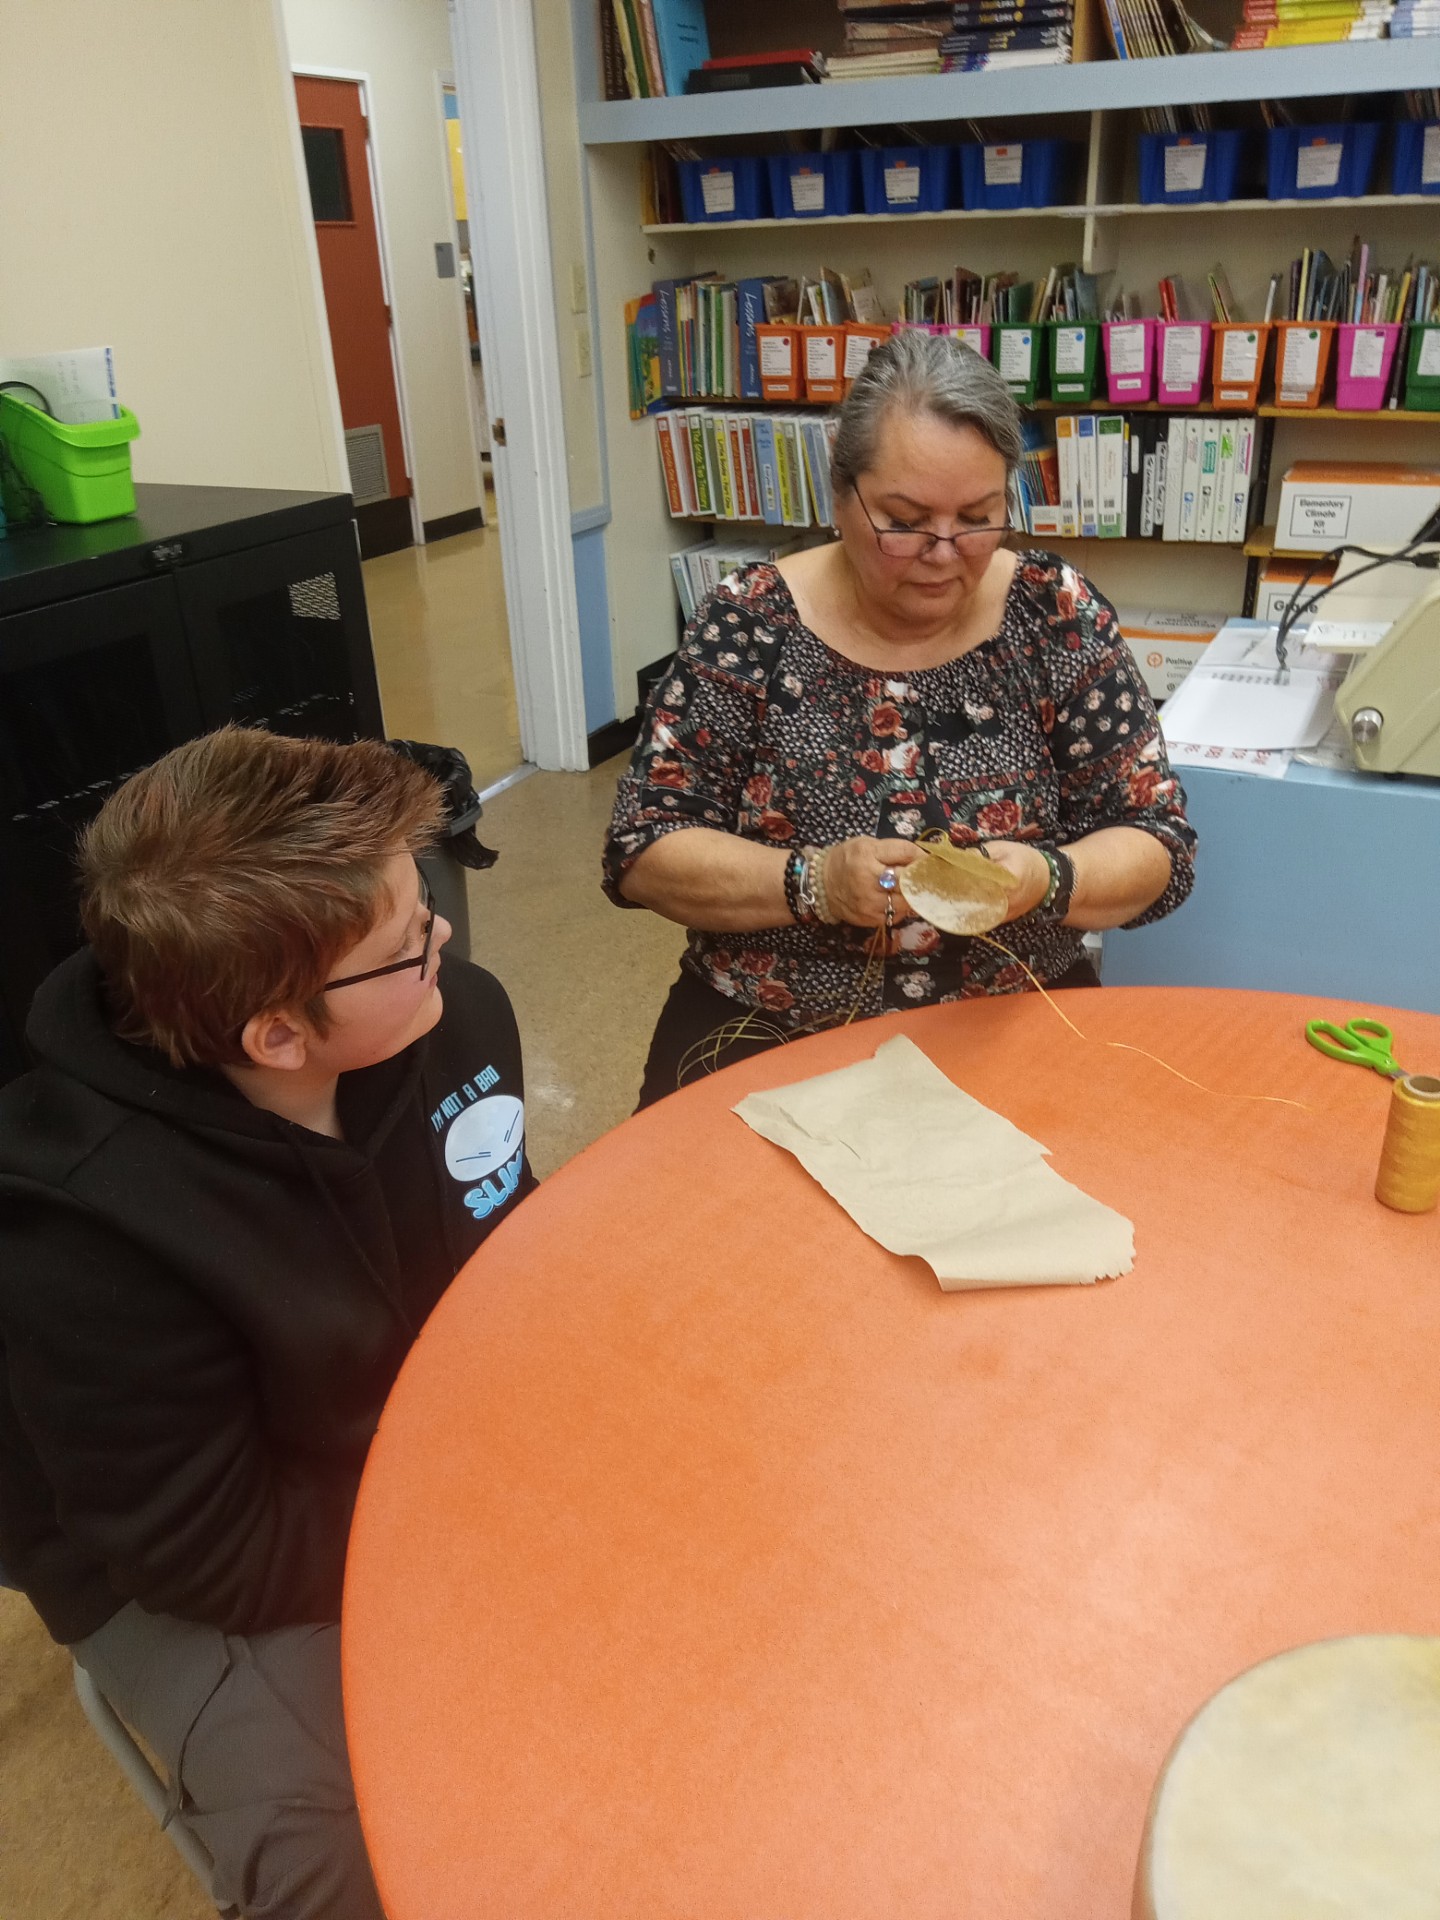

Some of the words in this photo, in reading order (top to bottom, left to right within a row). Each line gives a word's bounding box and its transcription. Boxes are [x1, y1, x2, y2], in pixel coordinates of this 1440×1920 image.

[744, 291, 758, 338] Lessons
[1299, 499, 1344, 510] Elementary
[1305, 509, 1336, 518] Climate
[1165, 657, 1193, 665] Positive
[431, 1108, 445, 1133] I'M
[440, 1091, 465, 1120] NOT
[462, 1083, 478, 1102] A
[473, 1064, 501, 1093] BAD
